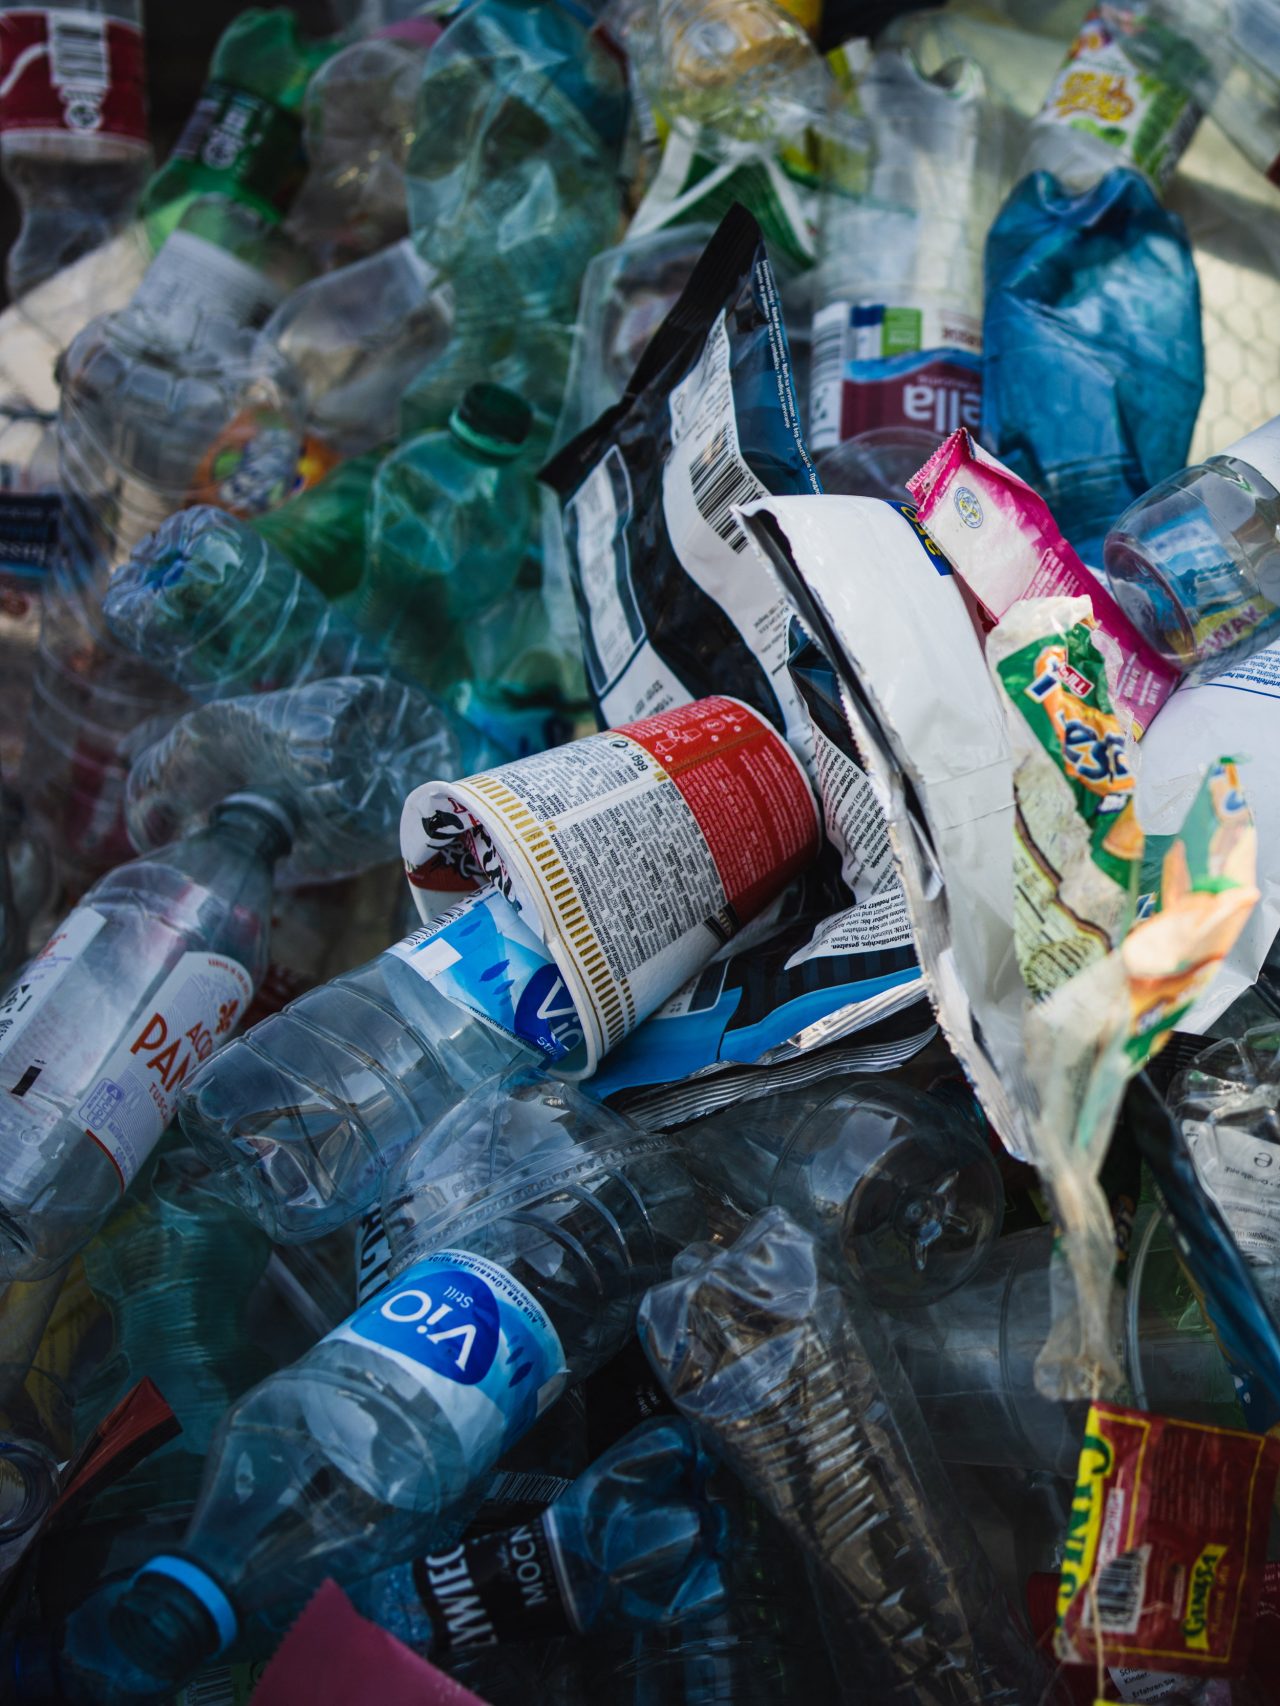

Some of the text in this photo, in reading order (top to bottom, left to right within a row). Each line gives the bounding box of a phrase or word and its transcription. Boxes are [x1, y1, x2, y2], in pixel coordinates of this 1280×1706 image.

[1234, 672, 1245, 680] mit
[631, 752, 648, 772] 66g
[571, 874, 580, 885] HOT
[593, 925, 606, 945] INSTANT
[830, 933, 910, 949] Maistortillachips, gesalzen.
[456, 1258, 507, 1293] LÜNEBURGER
[443, 1284, 474, 1308] Still
[505, 1289, 523, 1307] DER
[520, 1306, 538, 1324] AUS
[380, 1290, 476, 1371] ViO
